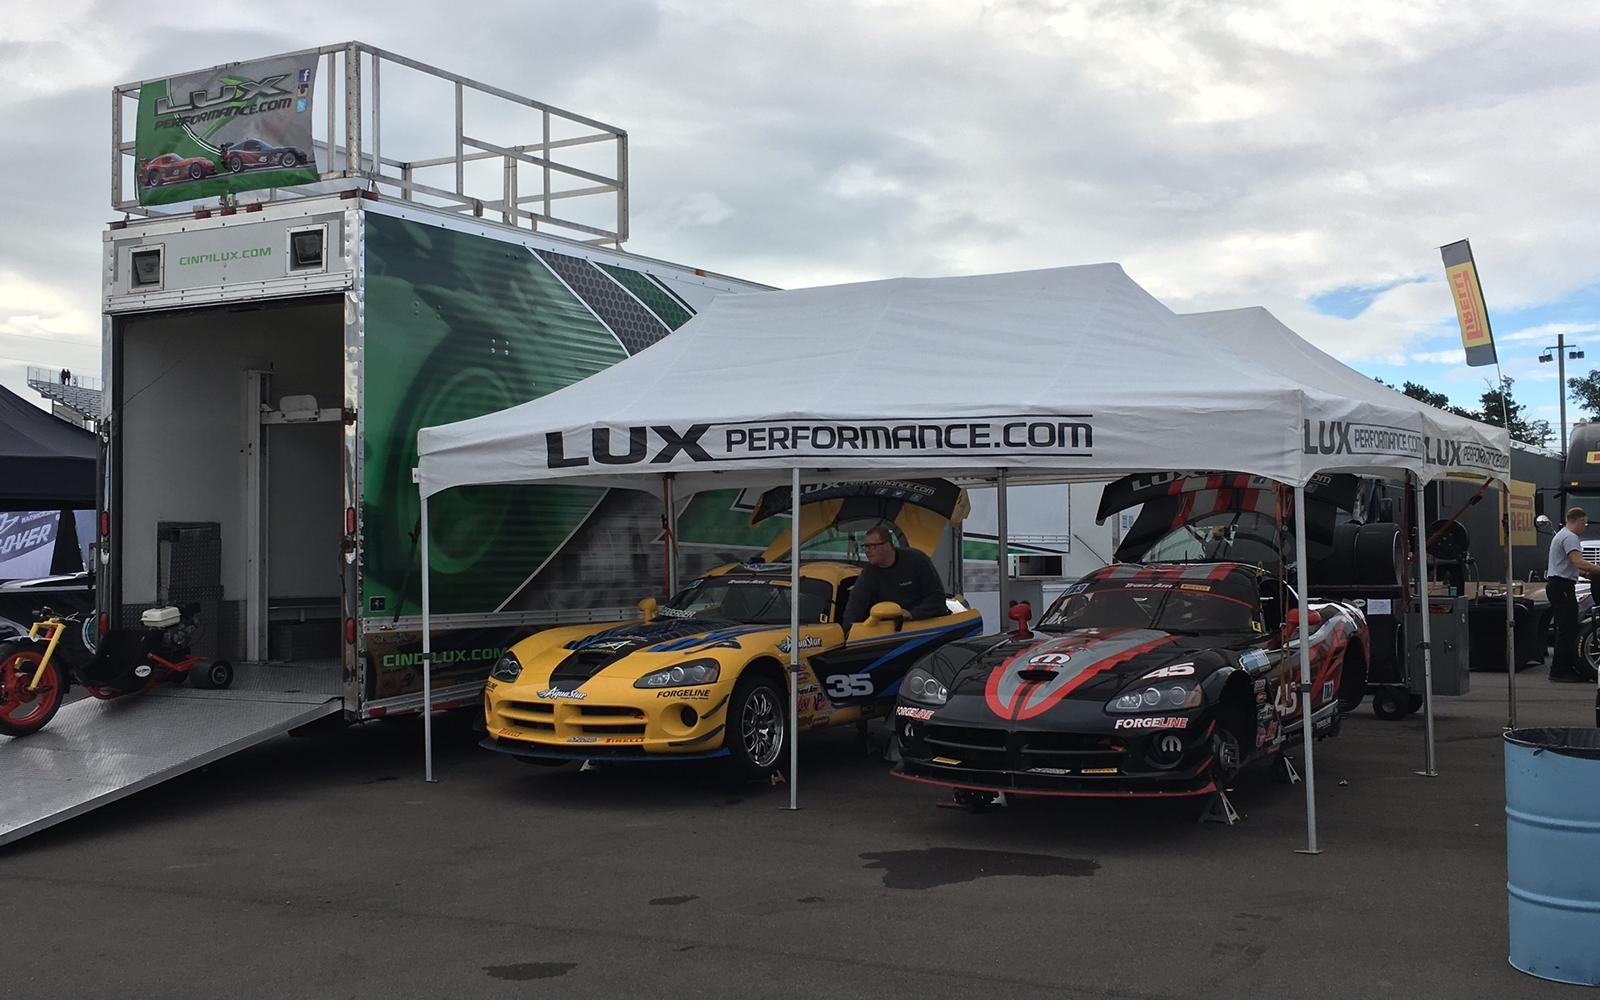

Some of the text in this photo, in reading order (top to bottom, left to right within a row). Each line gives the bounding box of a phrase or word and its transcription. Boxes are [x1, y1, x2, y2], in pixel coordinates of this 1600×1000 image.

[154, 74, 293, 117] LUX
[546, 421, 1093, 468] LUX PERFORMANCE.COM
[1304, 419, 1352, 455] LUX
[1424, 436, 1461, 467] LUX
[383, 647, 507, 667] CINDLUX.COM
[1141, 662, 1195, 680] 45
[656, 689, 711, 699] FORGELINE
[826, 673, 874, 698] 35
[1114, 717, 1188, 729] FORGELINE
